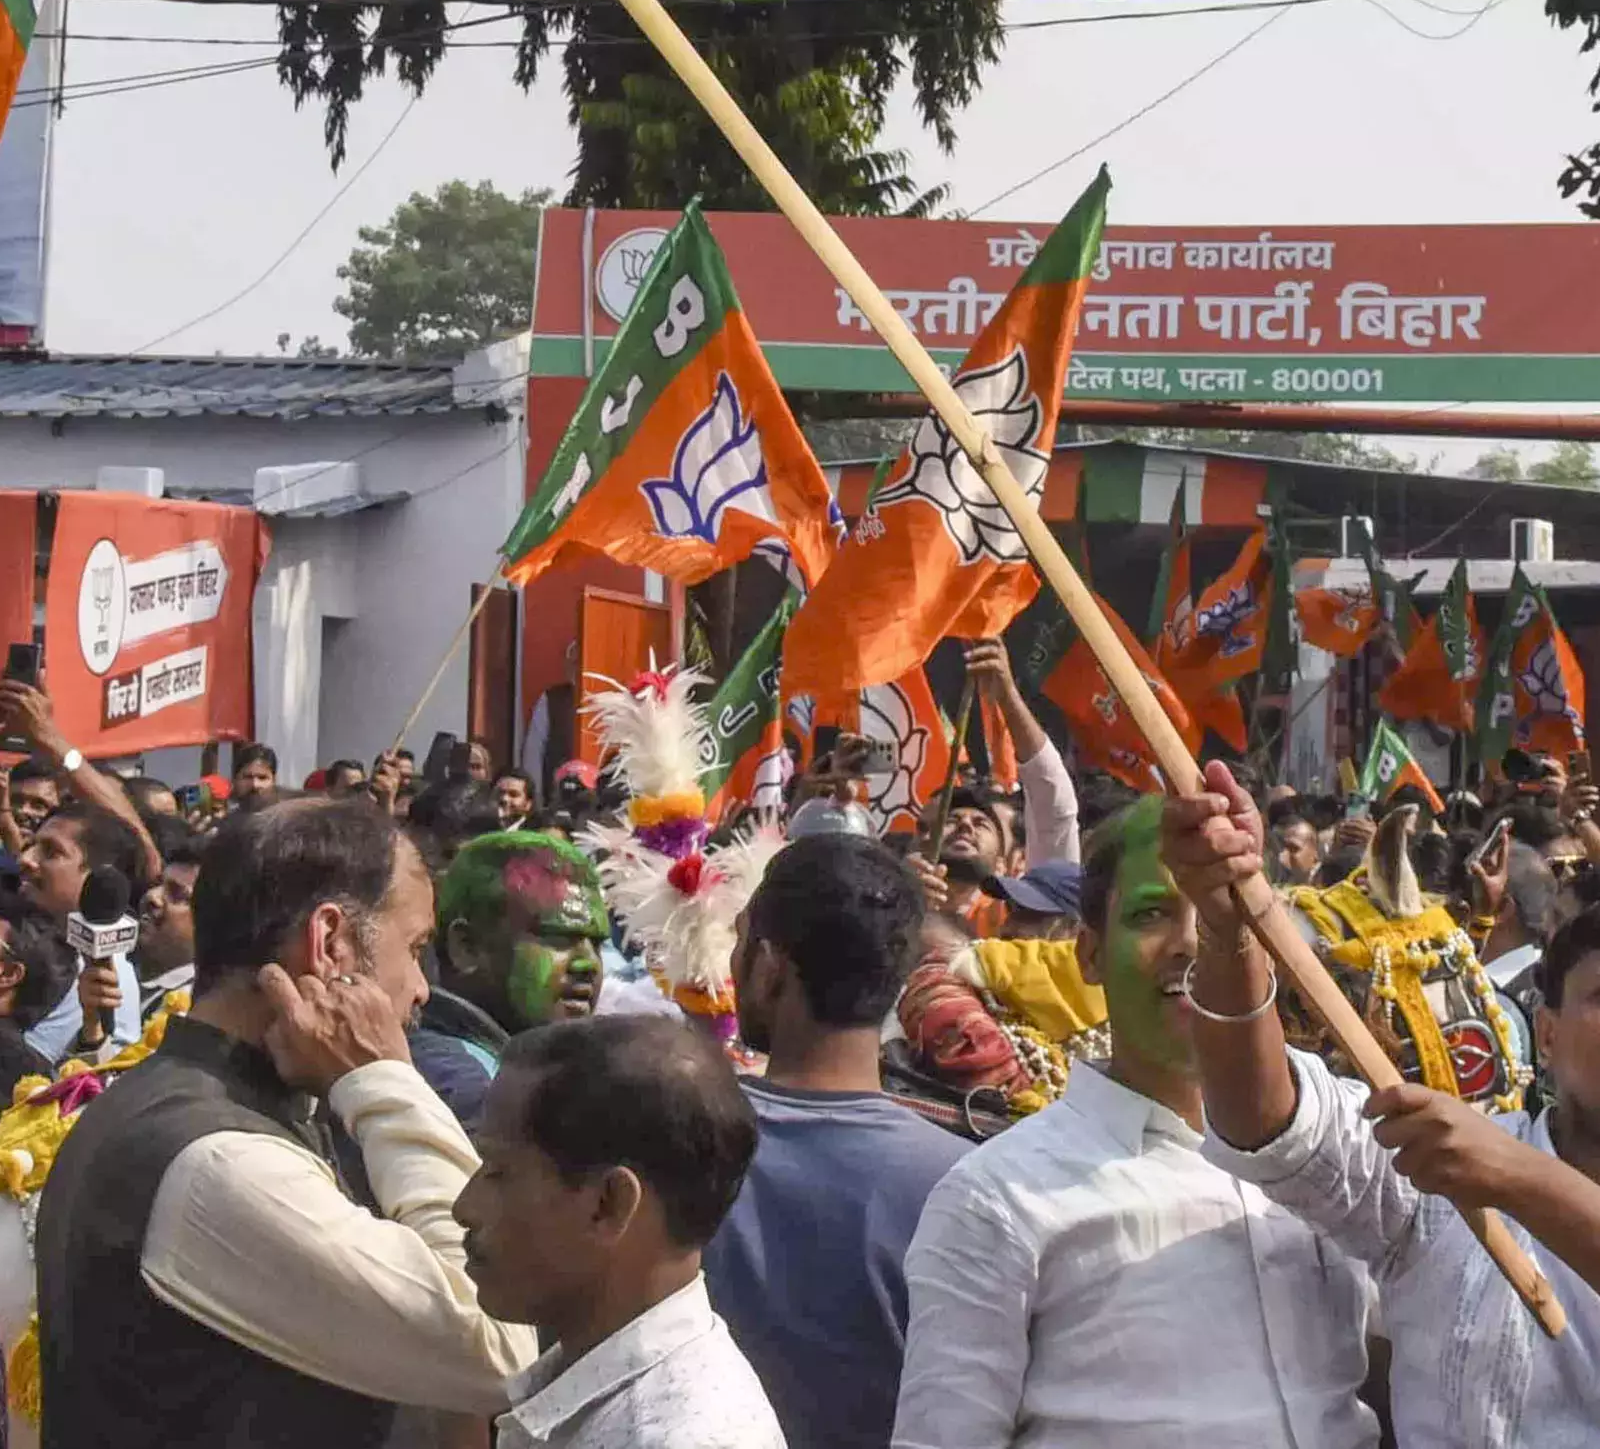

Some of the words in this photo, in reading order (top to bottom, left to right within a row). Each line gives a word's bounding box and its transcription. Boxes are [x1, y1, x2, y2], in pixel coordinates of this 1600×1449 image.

[986, 228, 1044, 269] प्रदे
[1090, 238, 1177, 281] ुनाव
[1182, 231, 1336, 271] कार्यालय
[1071, 295, 1185, 339] नता
[1194, 280, 1323, 347] पार्टी,
[1335, 281, 1487, 348] बिहार
[1178, 368, 1247, 392] पटना
[1271, 368, 1384, 393] 800001
